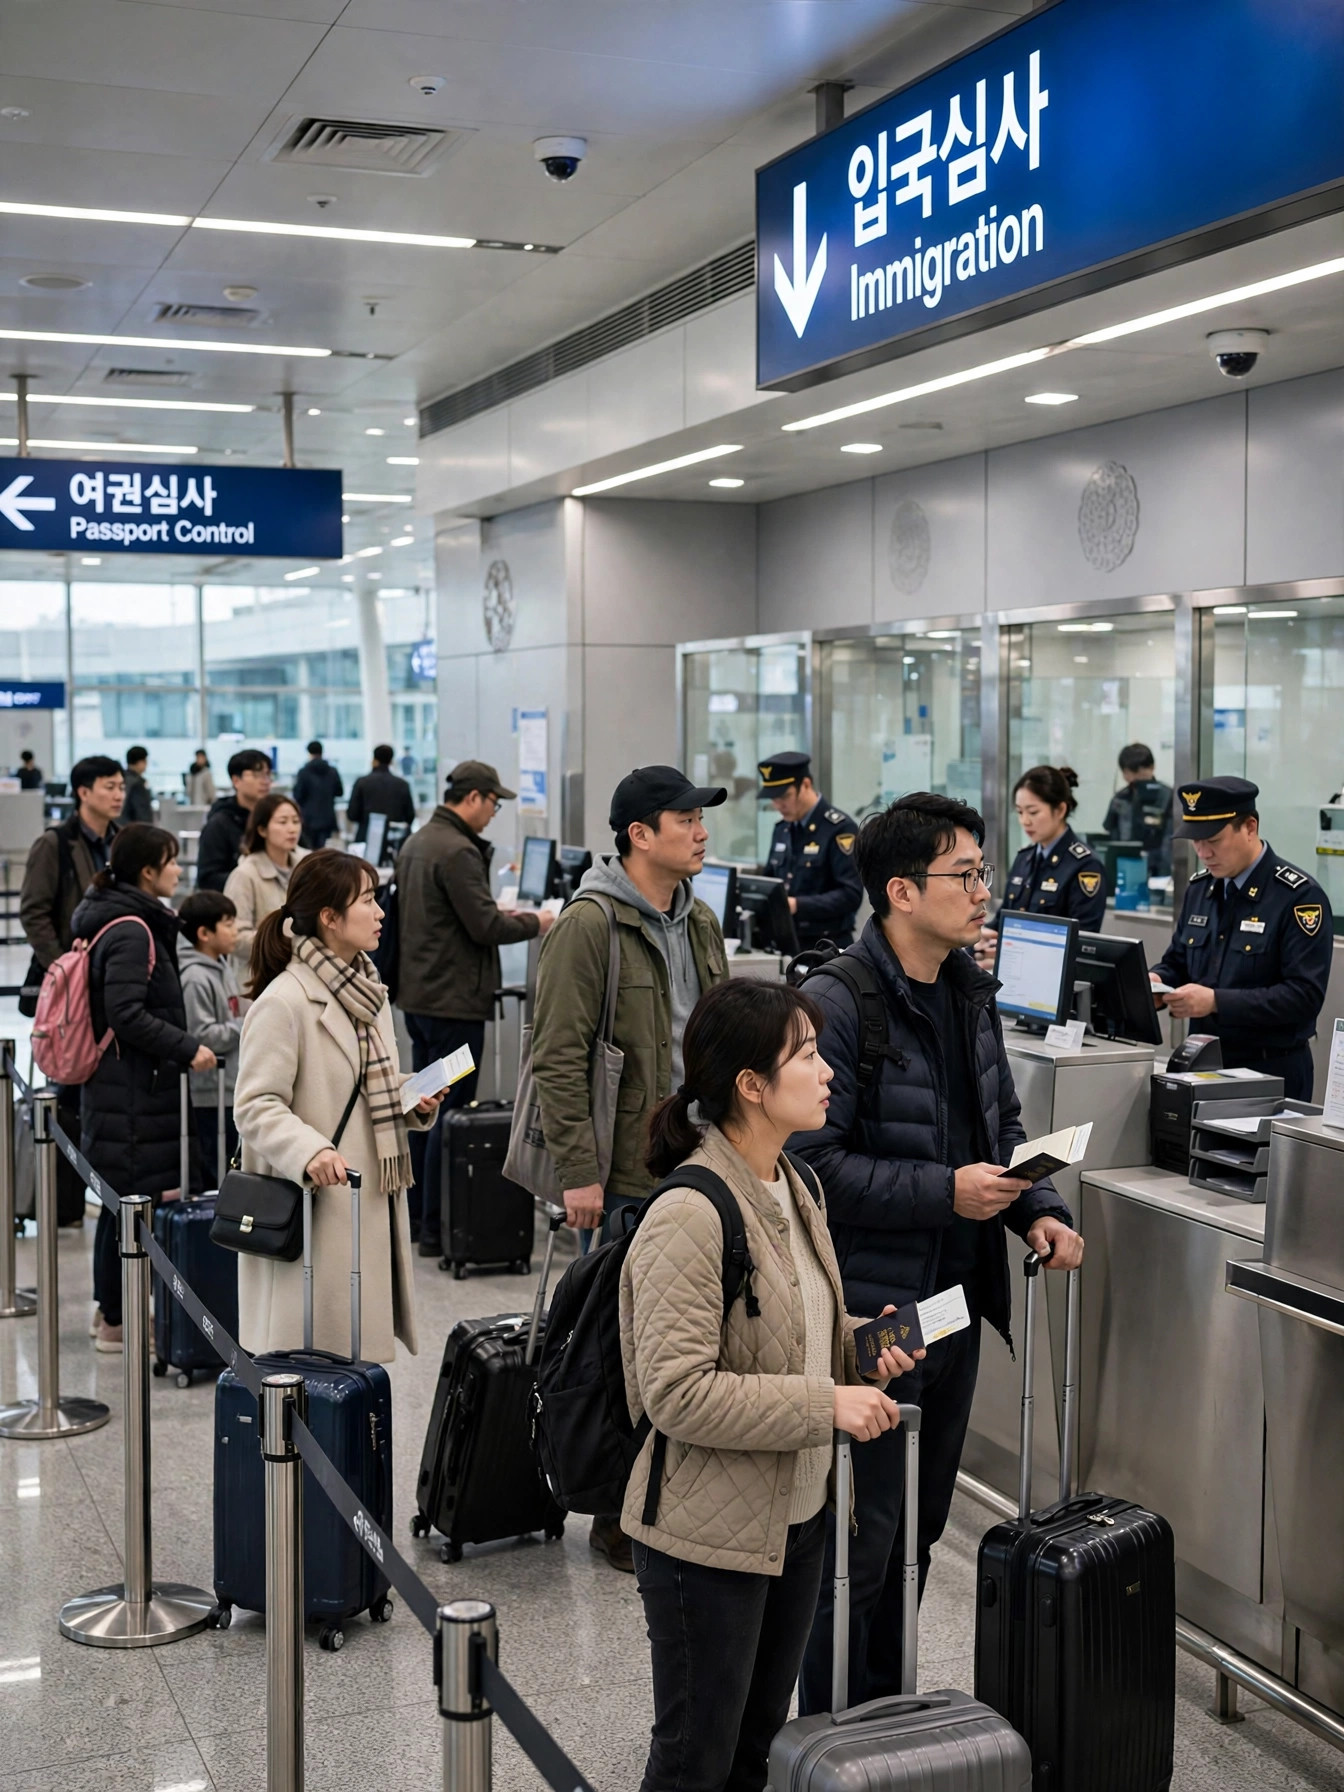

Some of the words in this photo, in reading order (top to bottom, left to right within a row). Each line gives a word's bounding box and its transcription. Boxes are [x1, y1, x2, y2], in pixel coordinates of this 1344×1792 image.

[848, 50, 1048, 248] 입국심사
[850, 203, 1045, 322] Immigration
[69, 471, 218, 517] 여권심사
[69, 517, 169, 546] Passport
[174, 520, 255, 545] Control
